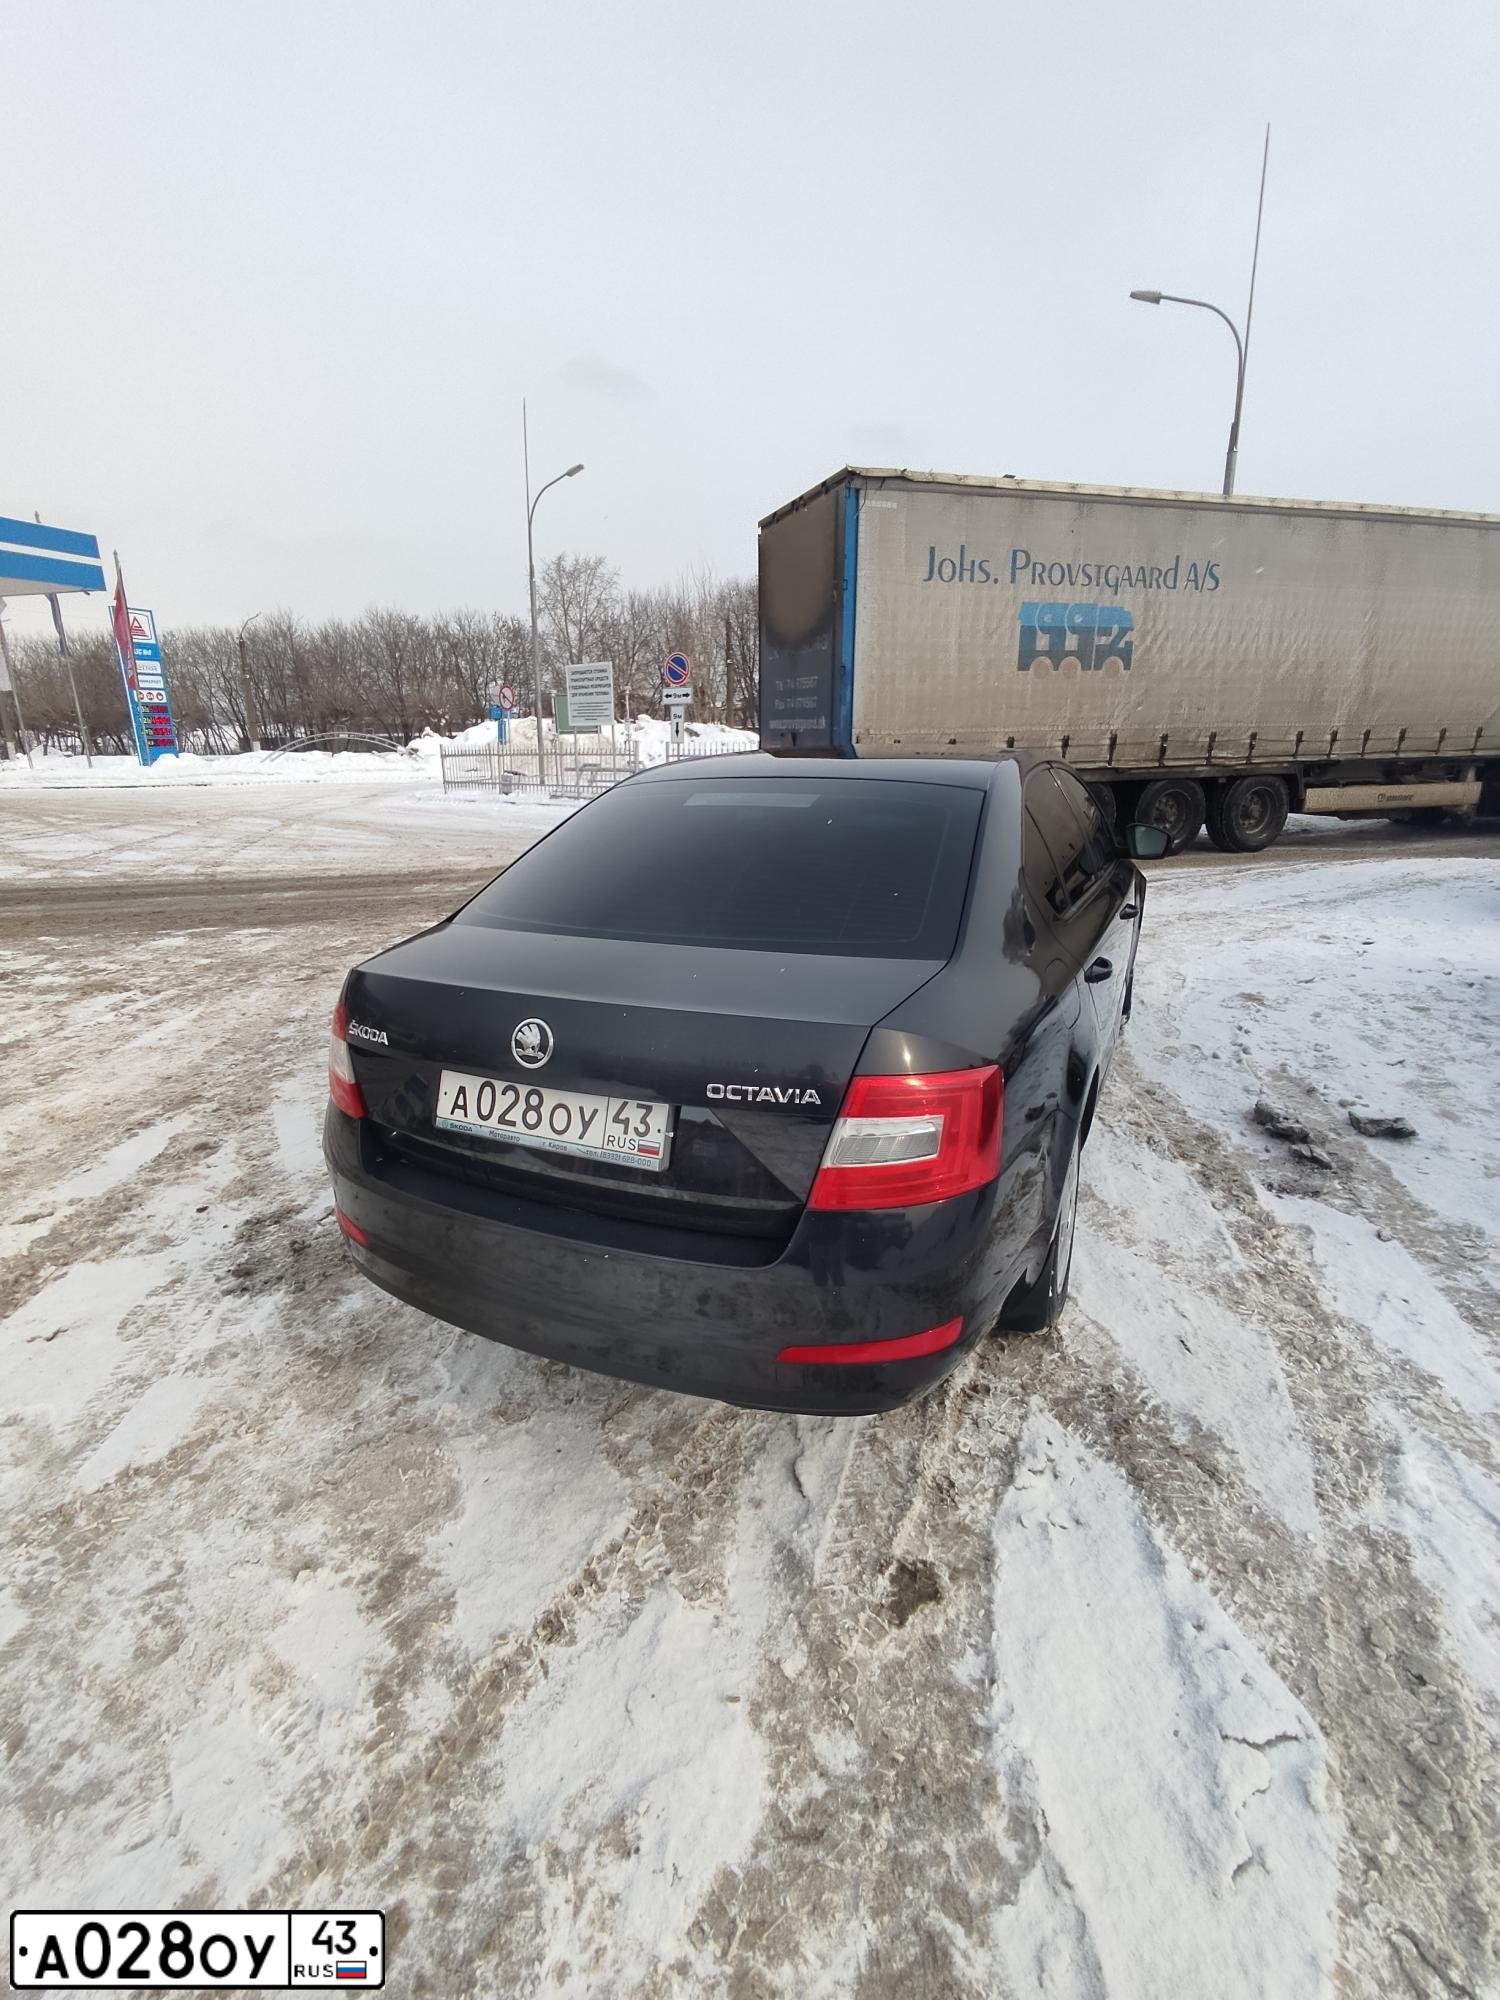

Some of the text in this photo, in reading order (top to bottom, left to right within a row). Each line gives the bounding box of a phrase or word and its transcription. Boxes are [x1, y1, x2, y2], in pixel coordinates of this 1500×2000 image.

[1183, 559, 1221, 592] A/S
[348, 1019, 389, 1046] ŠKODA
[706, 1083, 822, 1105] OCTAVIA
[450, 1080, 653, 1140] А028ОУ 43
[488, 1130, 521, 1142] Моторавто
[548, 1141, 568, 1152] Киров
[606, 1134, 637, 1151] RUS
